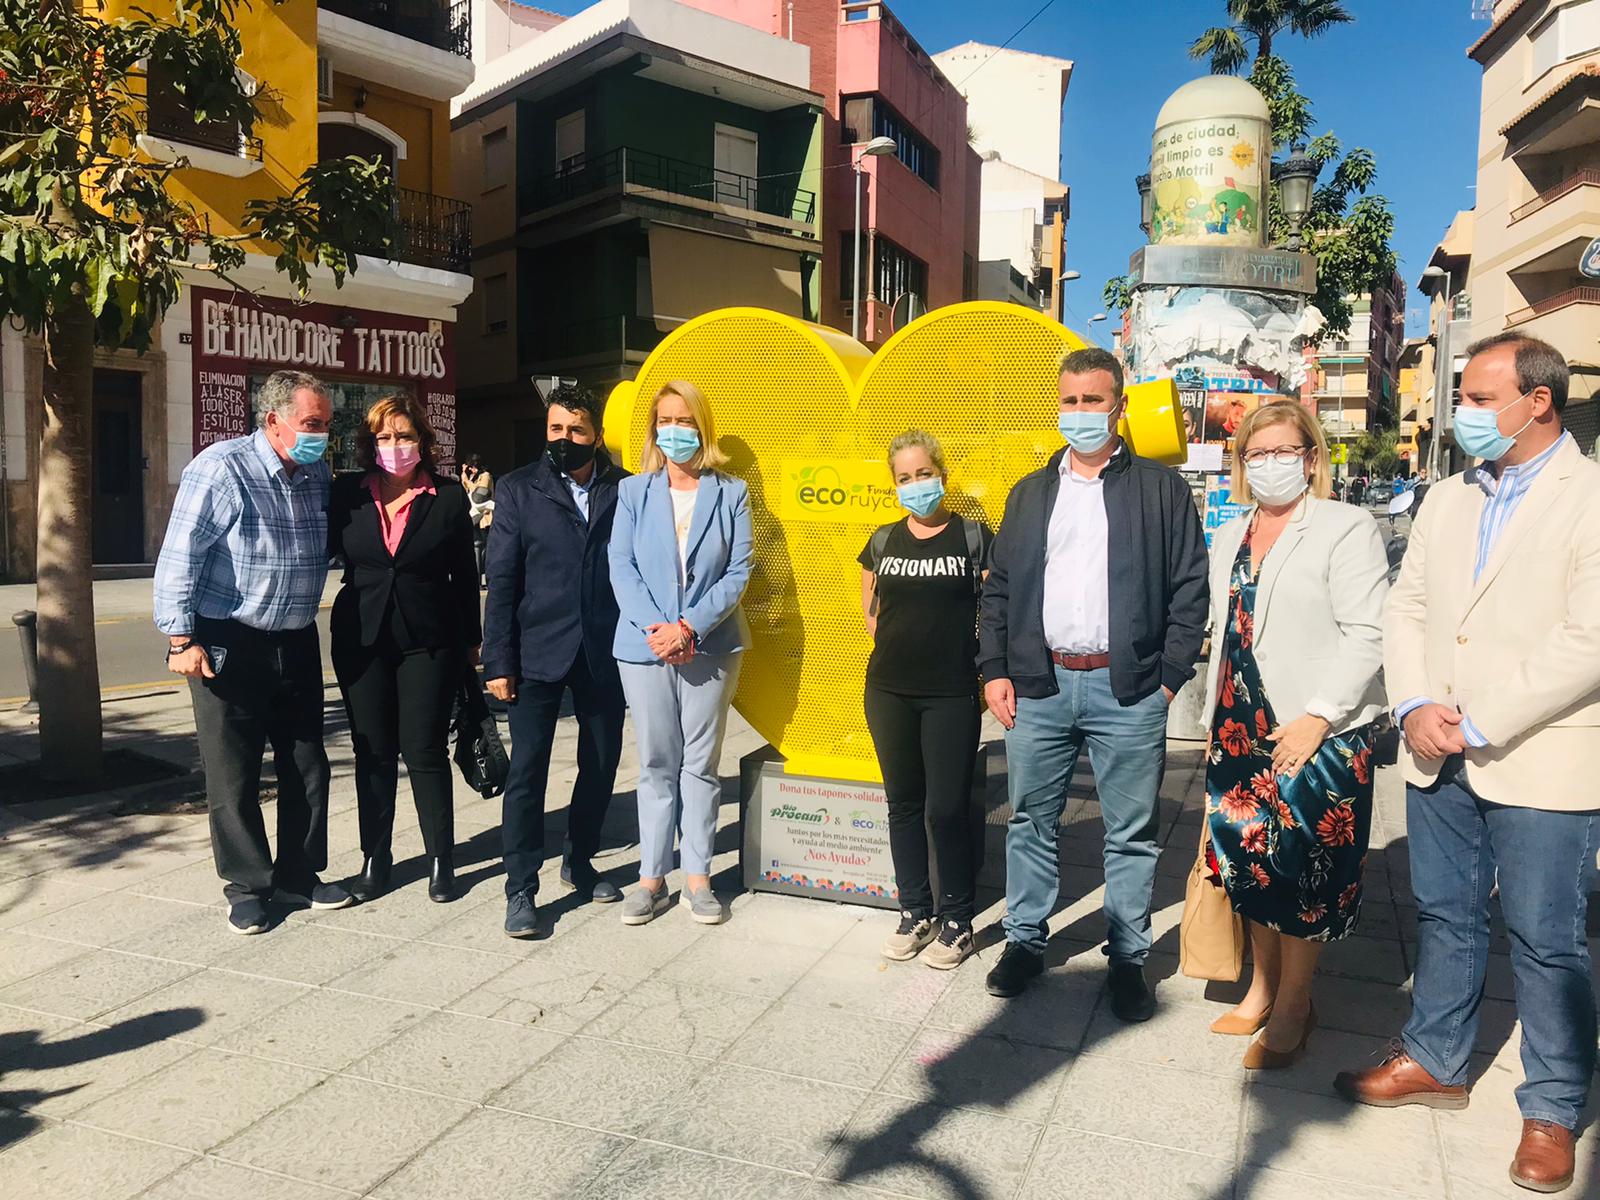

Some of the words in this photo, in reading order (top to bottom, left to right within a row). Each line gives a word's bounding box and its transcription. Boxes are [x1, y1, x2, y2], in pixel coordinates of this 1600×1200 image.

[1170, 132, 1183, 145] de
[1167, 146, 1202, 163] limpio
[1208, 146, 1224, 157] es
[1176, 163, 1213, 178] Motril
[182, 334, 192, 343] 17
[202, 299, 345, 368] BEHARDCORE
[354, 328, 446, 379] TATTOOS
[199, 371, 246, 391] ELIMINACION
[799, 485, 846, 506] eco
[879, 556, 966, 577] VISIONARY
[779, 783, 801, 794] Dona
[803, 786, 817, 796] tus
[818, 788, 852, 799] tapones
[770, 808, 822, 823] Procam
[782, 804, 797, 812] Bio
[834, 816, 841, 825] &
[852, 818, 874, 829] eco
[823, 830, 833, 839] los
[849, 836, 890, 846] necesitados
[797, 839, 818, 847] ayuda
[819, 839, 826, 847] al
[827, 842, 848, 850] medio
[849, 844, 882, 854] ambiente
[803, 848, 827, 862] ¿Nos
[829, 851, 871, 866] Ayudas?
